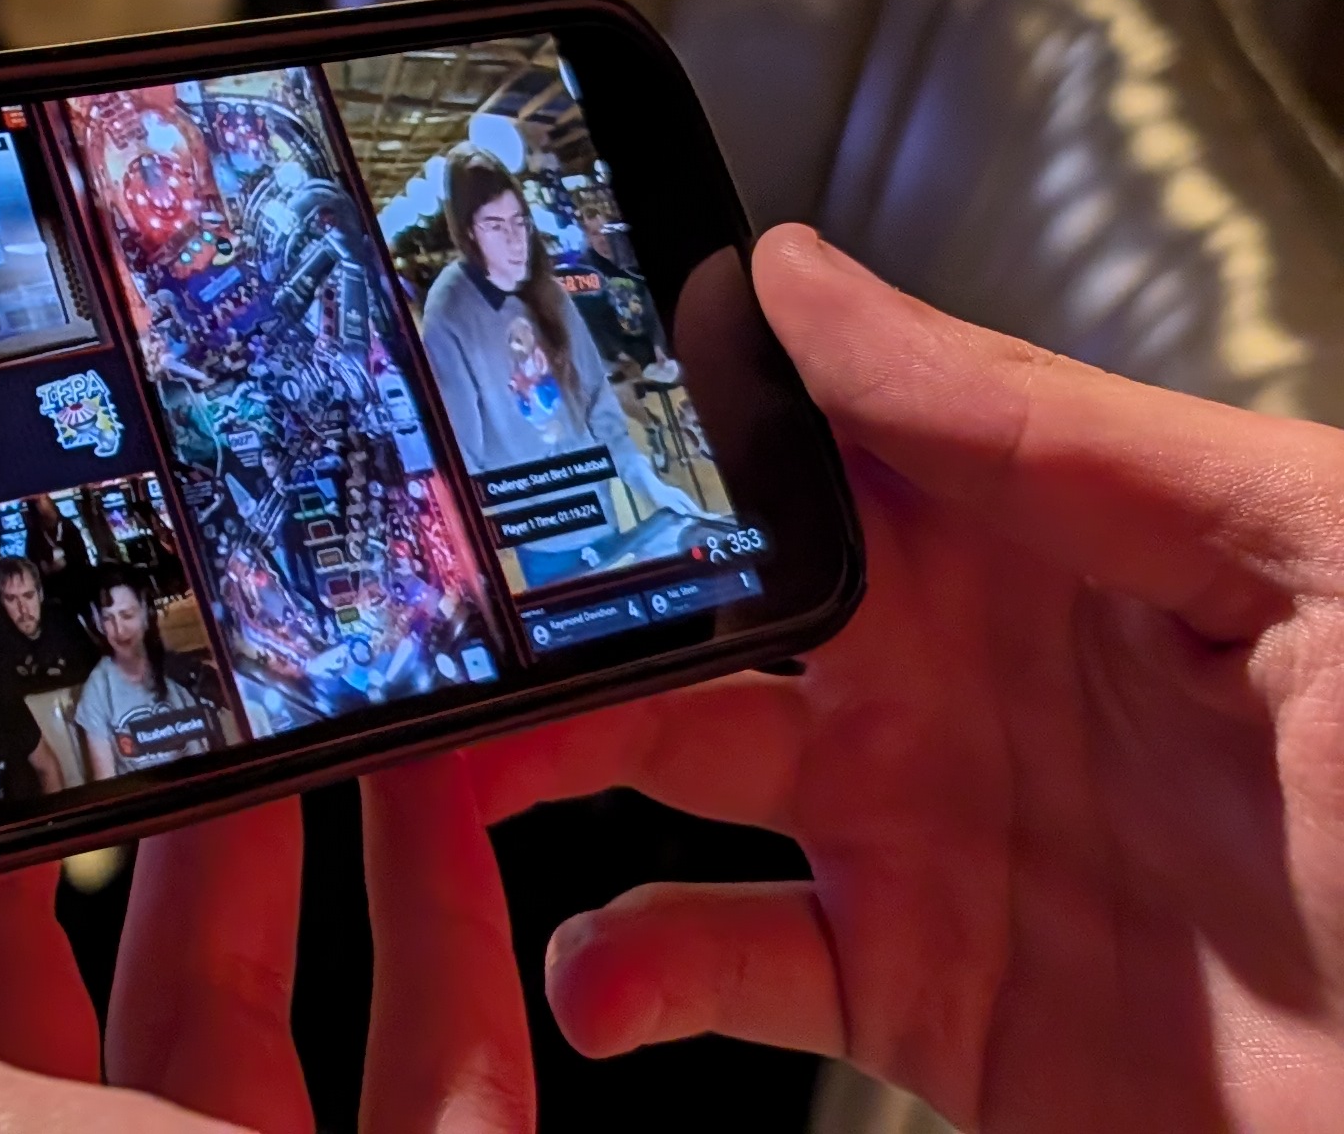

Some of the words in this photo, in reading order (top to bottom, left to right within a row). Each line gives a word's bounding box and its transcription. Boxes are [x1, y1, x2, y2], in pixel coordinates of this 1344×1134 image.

[726, 528, 762, 553] 353
[739, 571, 750, 589] 1
[628, 600, 640, 618] 4
